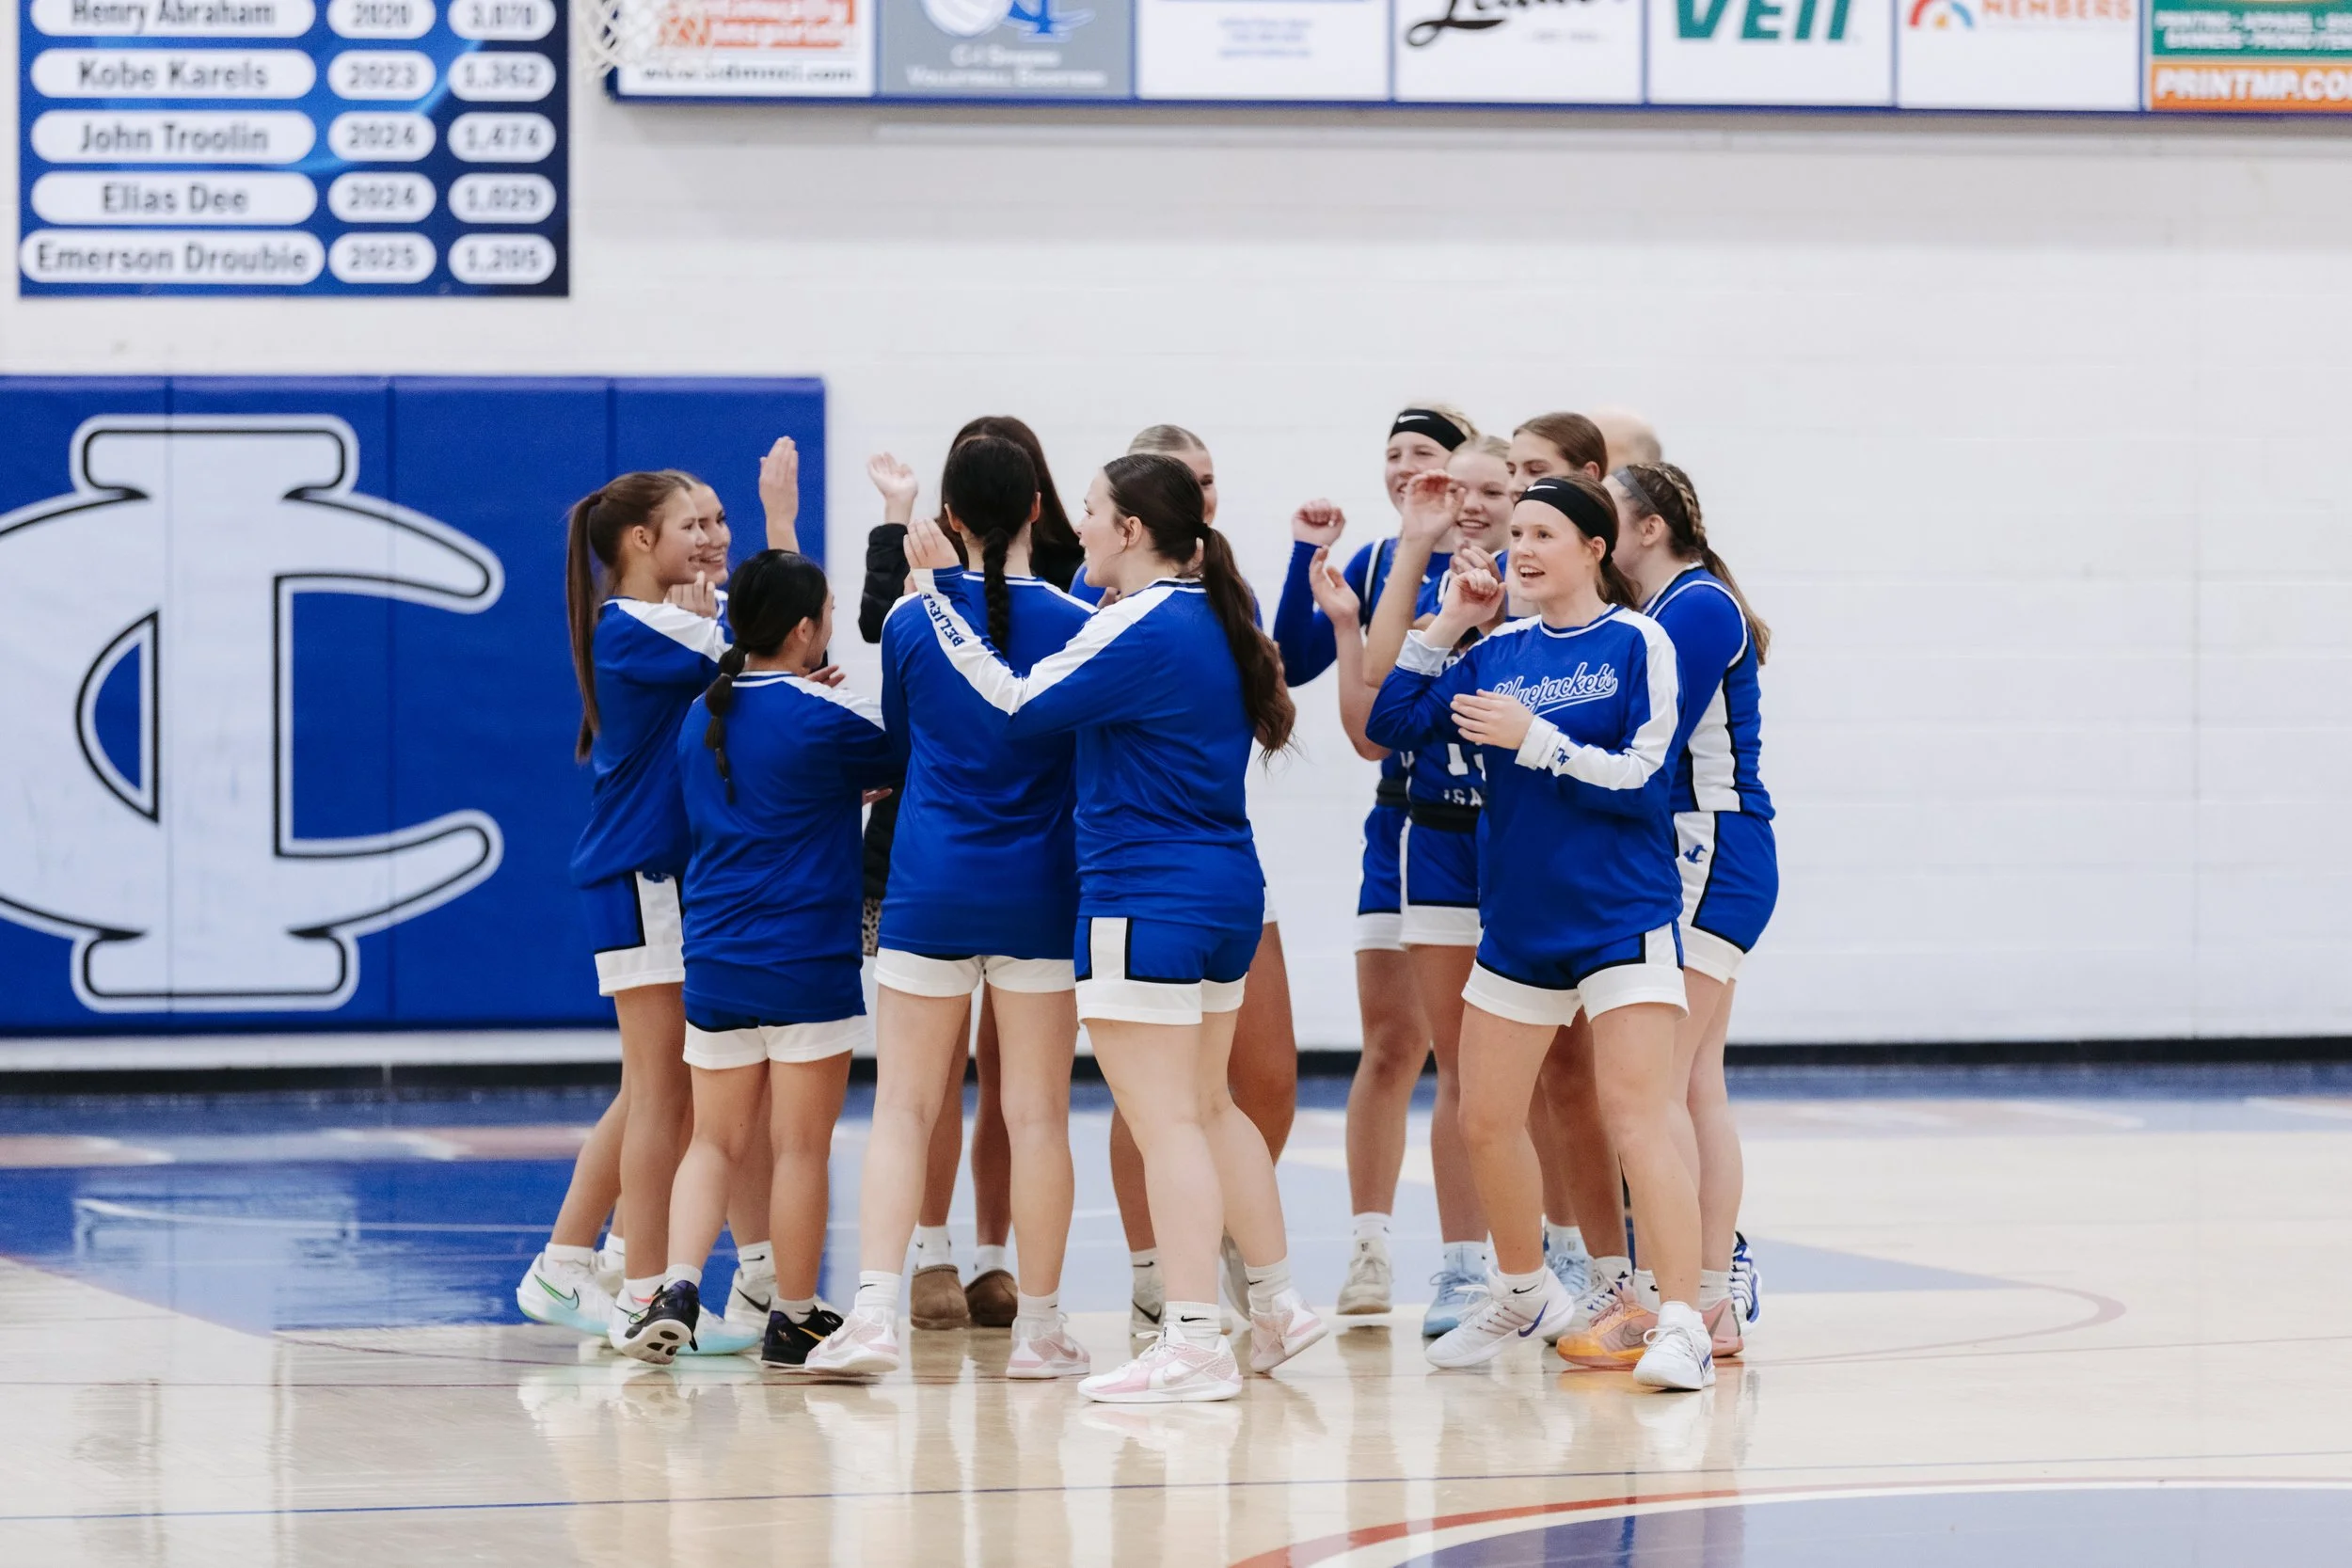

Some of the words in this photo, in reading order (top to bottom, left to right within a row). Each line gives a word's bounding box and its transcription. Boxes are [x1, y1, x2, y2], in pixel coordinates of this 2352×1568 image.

[78, 61, 155, 89] Kobe
[168, 61, 268, 89] Karels
[348, 64, 417, 89] 2023
[2155, 70, 2352, 101] PRINTMP.CO
[79, 123, 153, 152] John
[162, 123, 269, 152] Troolin
[348, 124, 417, 150] 2024
[102, 183, 178, 214] Elias
[188, 183, 248, 214] Dee
[348, 184, 417, 210] 2024
[37, 243, 174, 272] Emerson
[348, 245, 417, 271] 2025
